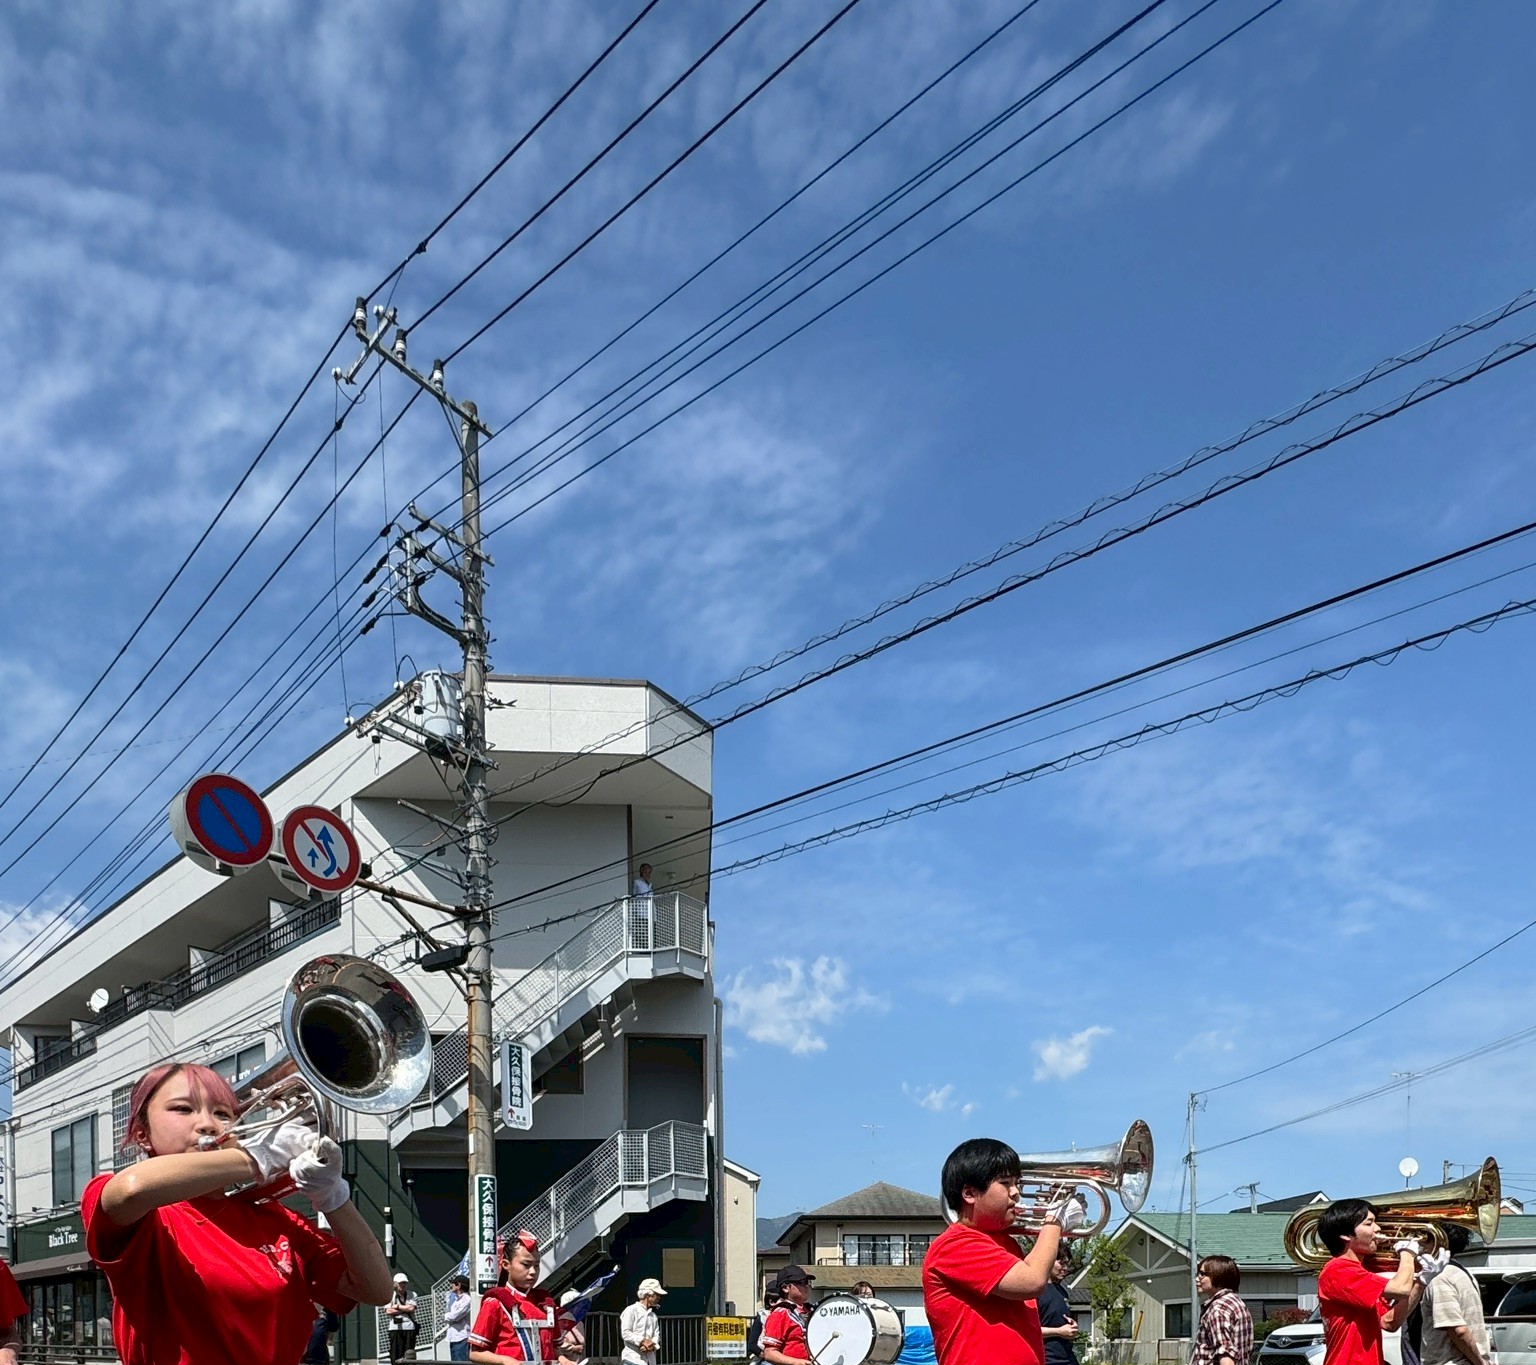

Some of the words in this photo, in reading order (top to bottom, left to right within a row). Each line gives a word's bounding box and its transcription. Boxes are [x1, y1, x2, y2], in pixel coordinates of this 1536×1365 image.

[510, 1046, 522, 1108] 大久保接骨院
[482, 1178, 495, 1254] 大久保接骨院
[48, 1233, 64, 1248] Black
[64, 1231, 79, 1245] Tree
[829, 1305, 861, 1317] YAMAHA
